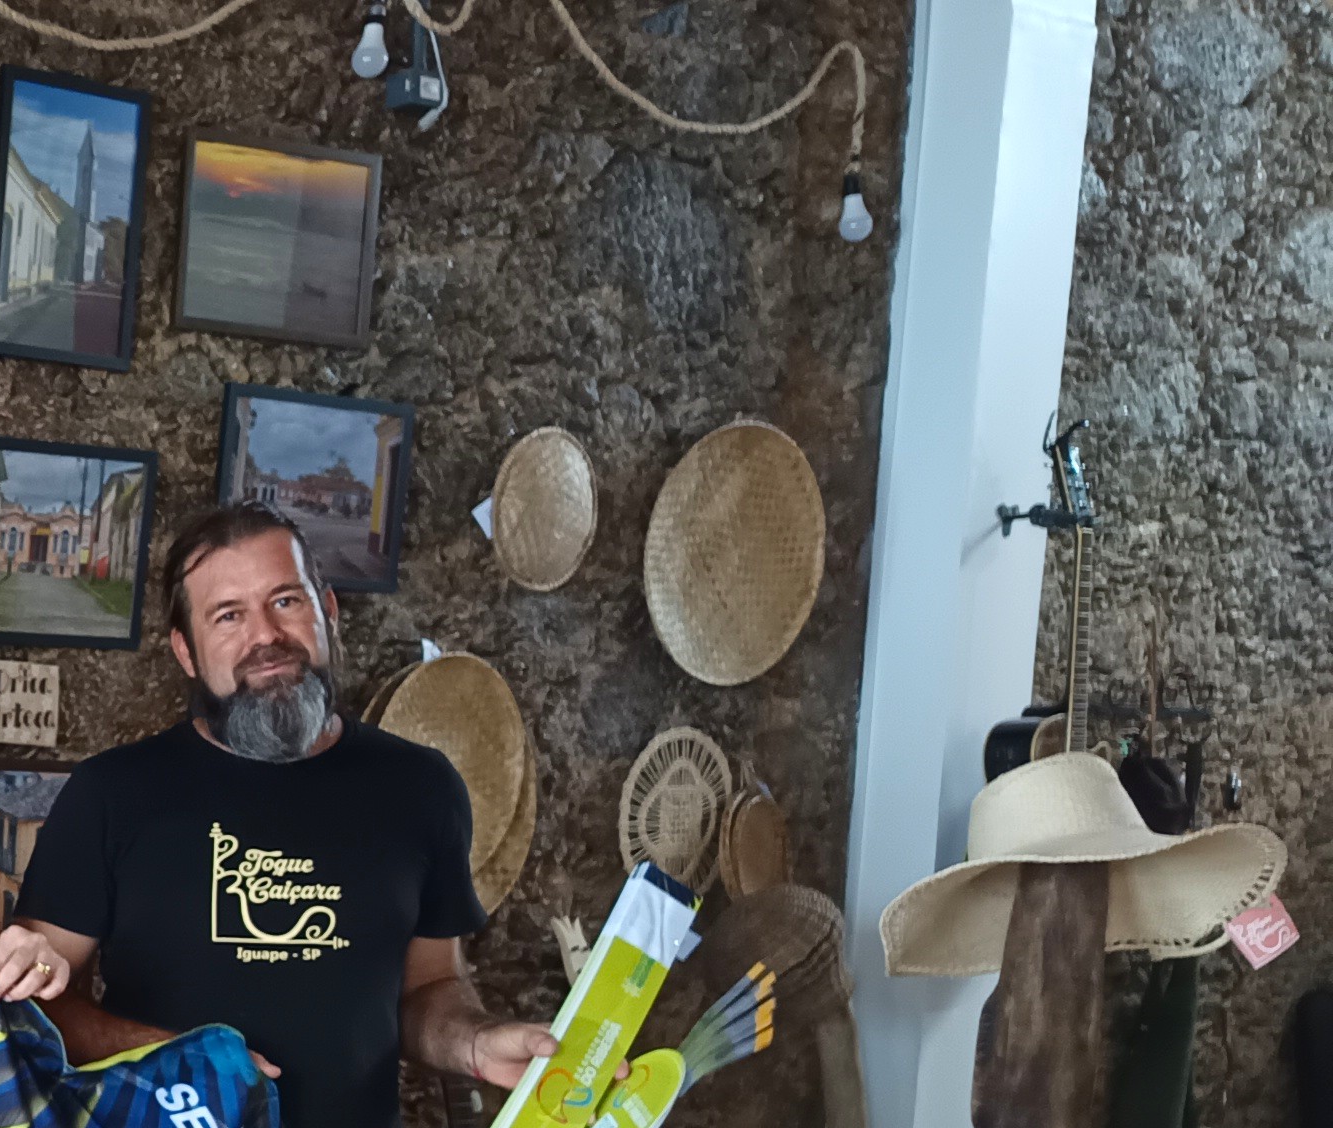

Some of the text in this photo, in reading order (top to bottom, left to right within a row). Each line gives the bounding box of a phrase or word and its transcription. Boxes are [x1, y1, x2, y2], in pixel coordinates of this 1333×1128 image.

[239, 849, 314, 877] Toque
[246, 876, 342, 905] Caiçara
[236, 947, 288, 963] Iguape
[302, 948, 322, 961] SP
